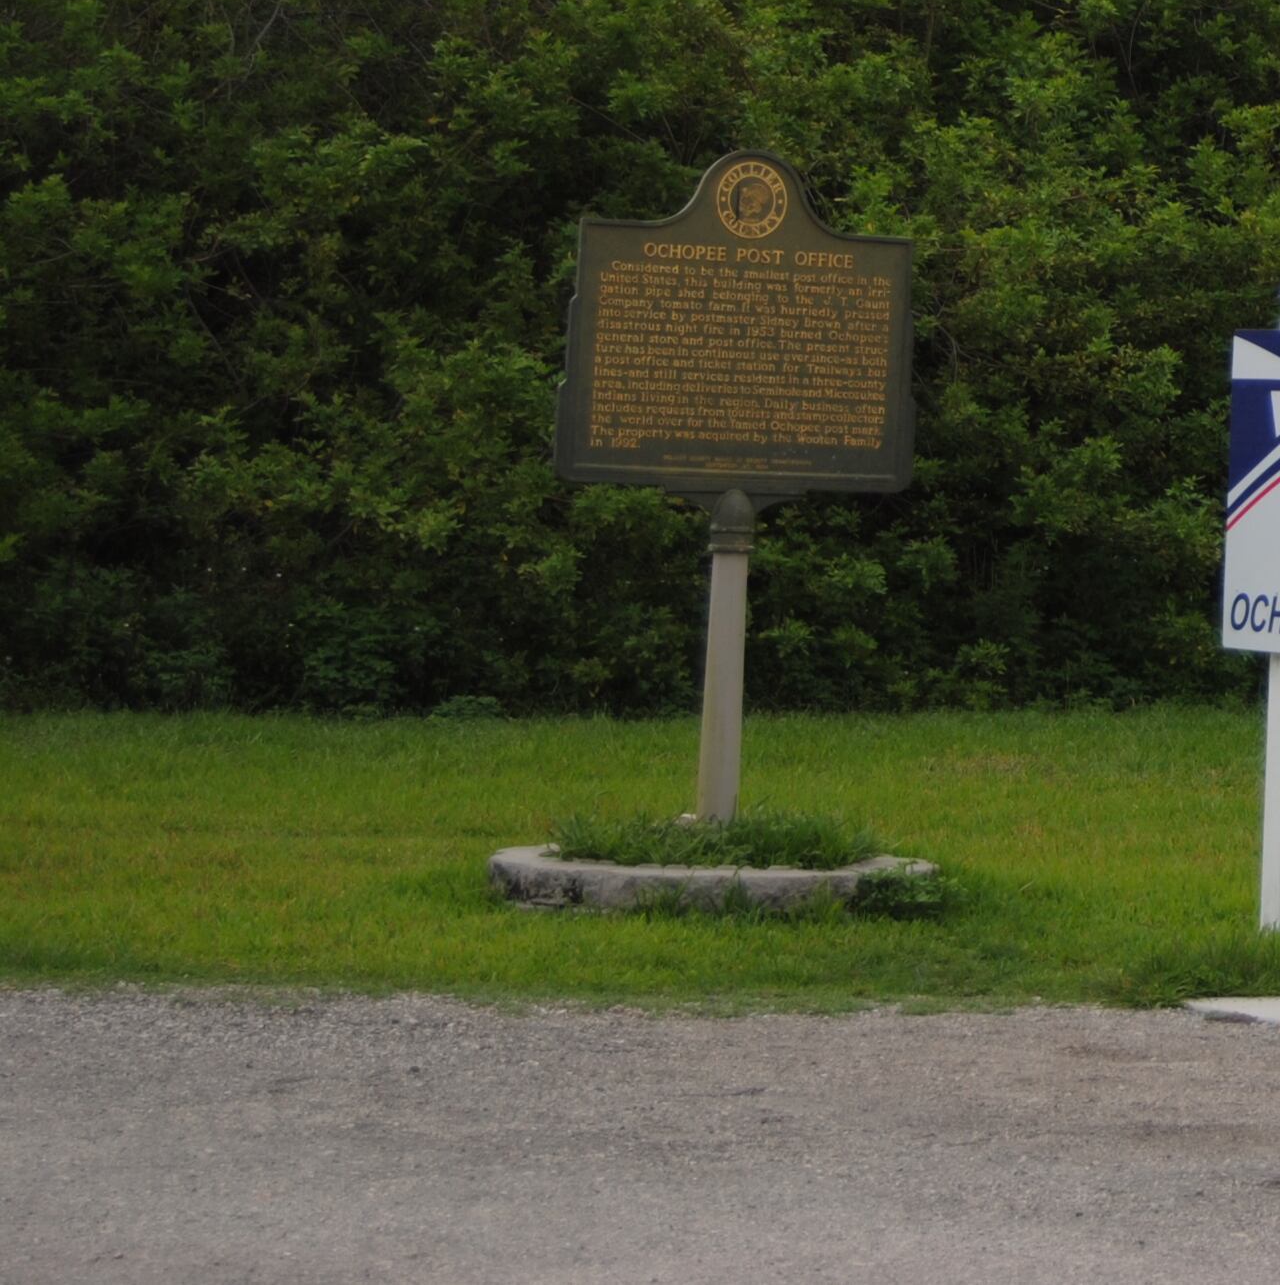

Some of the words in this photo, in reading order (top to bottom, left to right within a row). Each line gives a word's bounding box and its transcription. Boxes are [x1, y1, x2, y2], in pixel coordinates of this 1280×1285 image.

[722, 163, 782, 193] COLLIER
[722, 211, 780, 234] COUNTY
[643, 242, 727, 262] OCHOPEE
[736, 248, 784, 265] POST
[794, 251, 854, 269] OFFICE
[600, 271, 638, 283] United
[684, 276, 707, 287] this
[712, 277, 761, 292] building
[794, 282, 842, 296] formerly
[611, 260, 679, 274] Considered
[684, 265, 695, 275] to
[700, 266, 713, 276] be
[719, 267, 738, 277] the
[743, 269, 789, 280] smallest
[793, 272, 816, 283] post
[820, 273, 852, 284] office
[855, 275, 867, 285] in
[873, 276, 890, 286] the
[645, 286, 671, 299] pipe
[677, 288, 704, 298] shed
[712, 289, 768, 304] belonging
[776, 293, 788, 303] to
[795, 294, 813, 304] the
[599, 294, 652, 309] Company
[660, 298, 702, 310] tomato
[754, 305, 775, 313] was
[780, 304, 835, 319] hurriedly
[598, 307, 620, 317] into
[624, 309, 666, 319] service
[670, 310, 685, 323] by
[690, 312, 755, 324] postmaster
[804, 316, 840, 328] Brown
[847, 319, 875, 330] after
[598, 318, 660, 330] disastrous
[666, 322, 696, 334] night
[702, 323, 723, 334] fire
[729, 325, 740, 334] in
[780, 327, 821, 338] burned
[596, 332, 643, 342] general
[649, 333, 679, 344] store
[681, 335, 703, 345] and
[707, 337, 733, 348] post
[777, 339, 801, 350] The
[806, 343, 849, 353] present
[625, 343, 645, 353] has
[677, 346, 688, 356] in
[759, 352, 780, 360] use
[783, 353, 809, 361] ever
[604, 355, 630, 366] post
[633, 355, 669, 366] office
[672, 357, 694, 367] and
[735, 360, 775, 371] station
[782, 362, 800, 372] for
[654, 368, 677, 378] still
[682, 371, 730, 381] services
[788, 375, 799, 384] in
[740, 384, 751, 394] to
[640, 392, 674, 406] living
[677, 394, 689, 404] in
[764, 397, 798, 411] Daily
[855, 402, 885, 413] often
[697, 406, 725, 416] from
[591, 424, 614, 435] The
[617, 427, 670, 440] property
[753, 431, 767, 444] by
[619, 414, 653, 425] world
[688, 416, 704, 427] for
[708, 418, 727, 428] the
[824, 424, 848, 435] post
[590, 436, 602, 446] in
